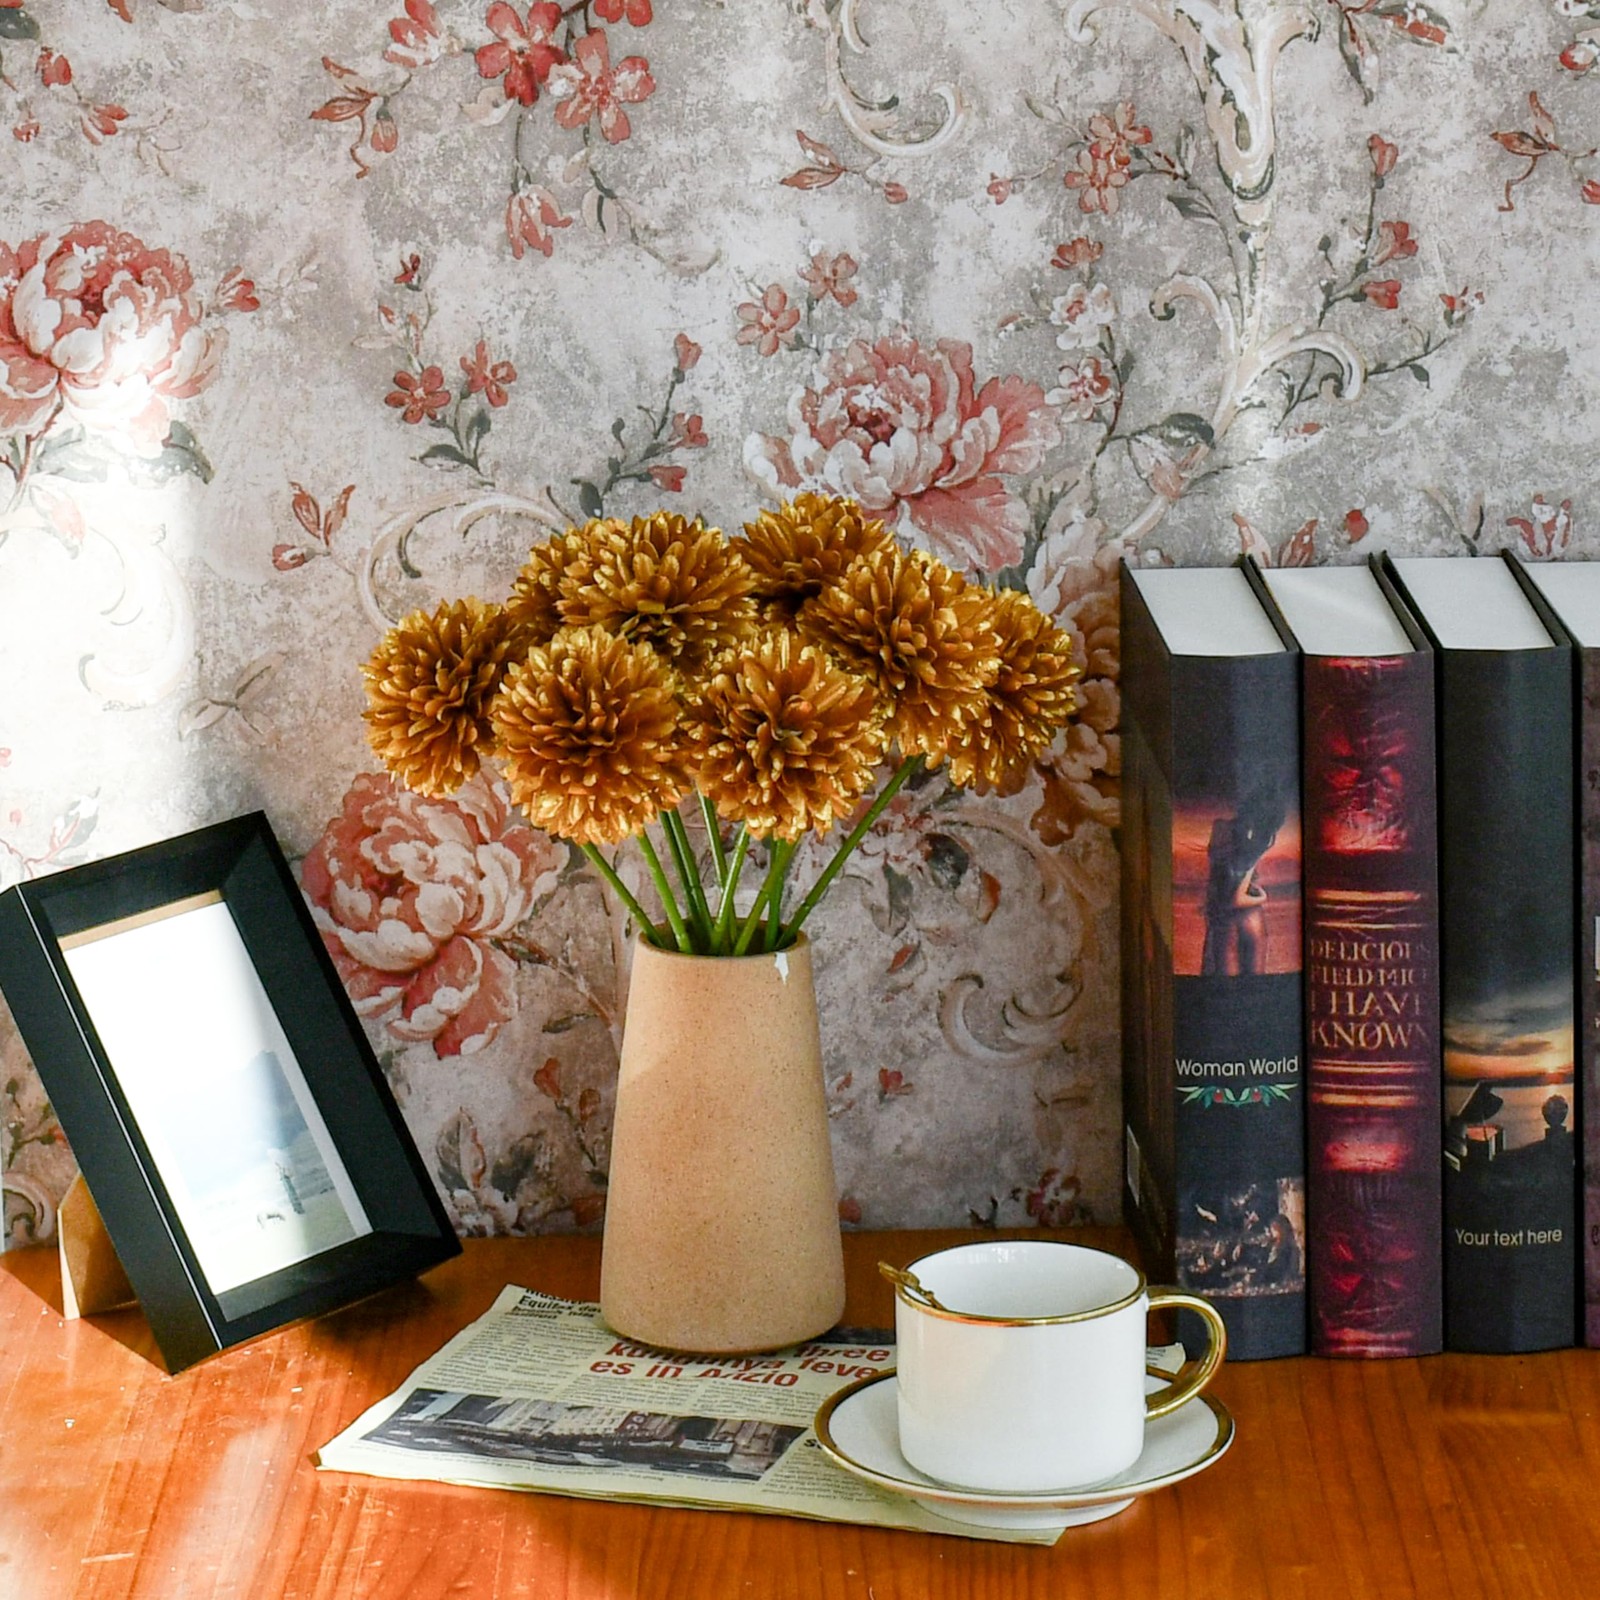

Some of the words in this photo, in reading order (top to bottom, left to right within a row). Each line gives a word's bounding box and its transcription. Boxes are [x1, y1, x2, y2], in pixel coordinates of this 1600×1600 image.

[1175, 1058, 1246, 1077] Woman
[1249, 1055, 1299, 1076] World
[1455, 1228, 1490, 1246] Your
[1494, 1229, 1524, 1246] text
[1527, 1228, 1563, 1245] here
[589, 1360, 636, 1376] es
[646, 1361, 684, 1379] in
